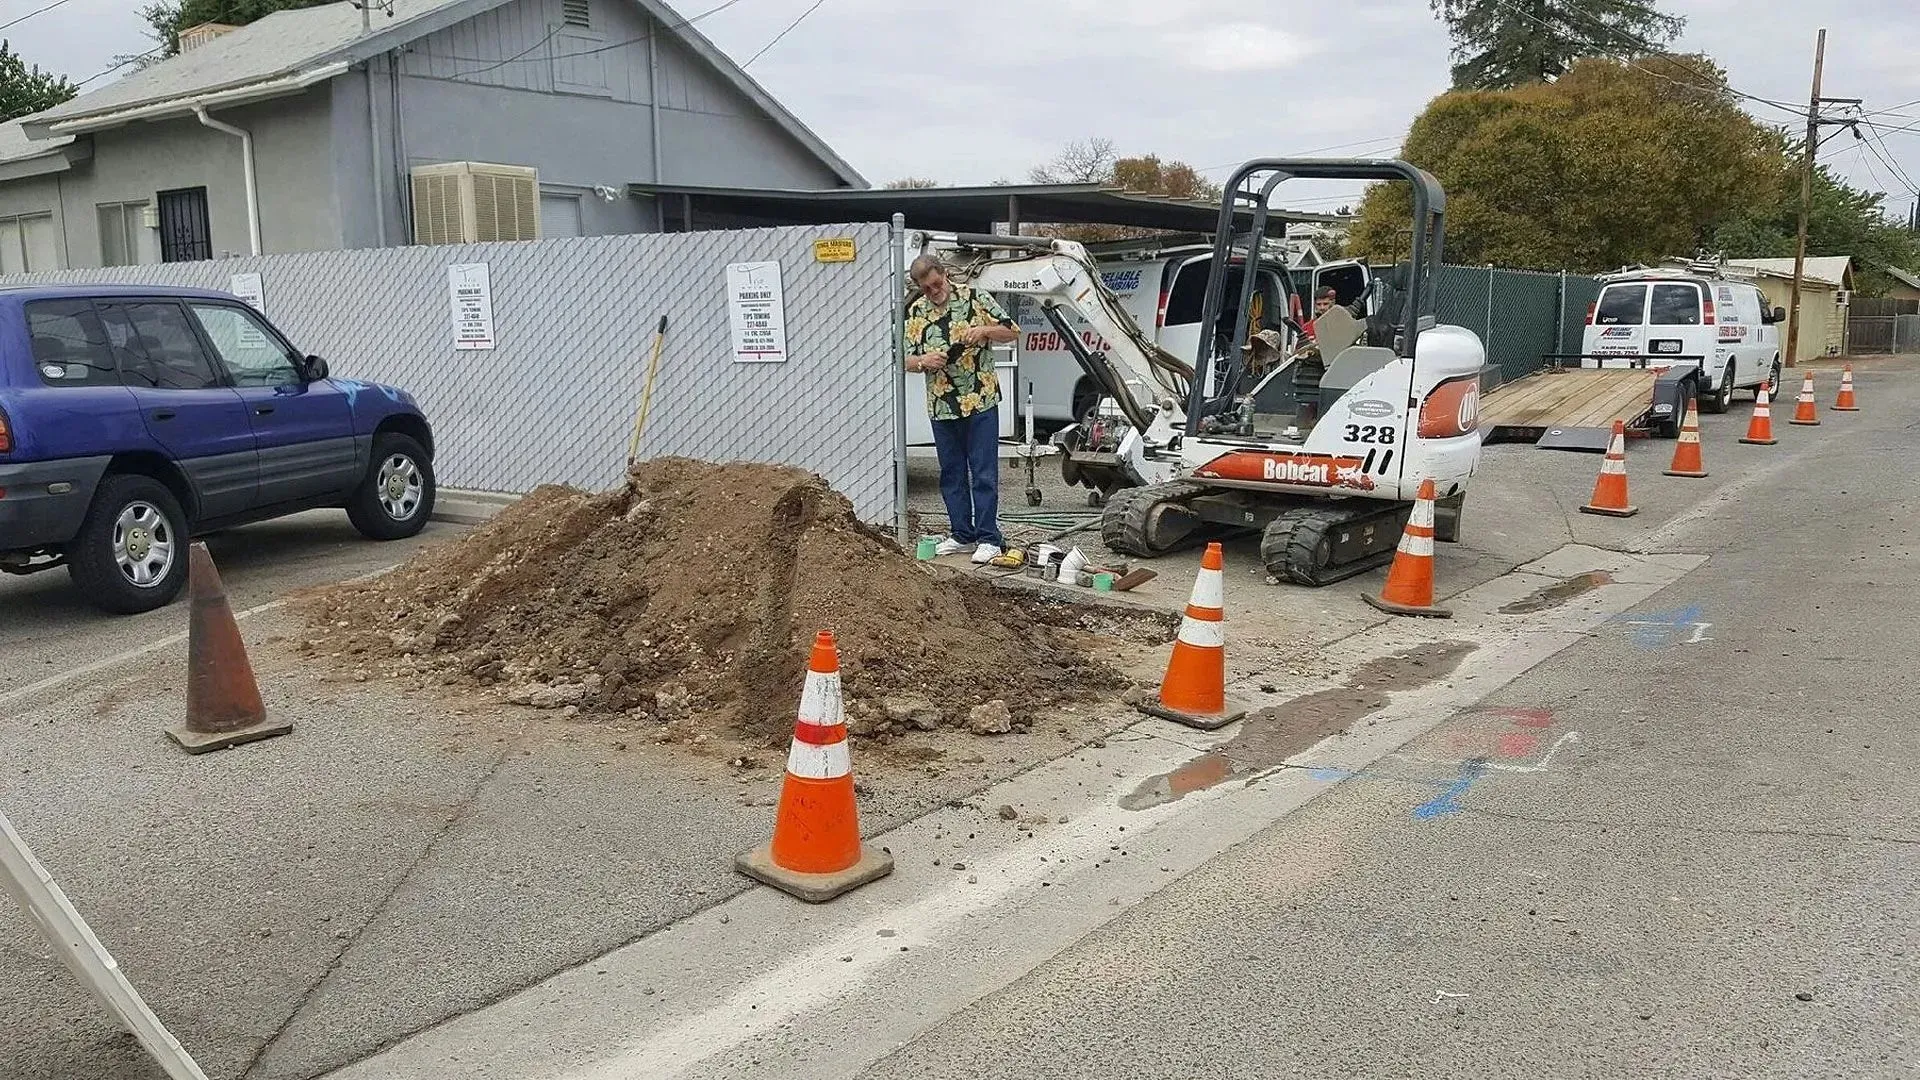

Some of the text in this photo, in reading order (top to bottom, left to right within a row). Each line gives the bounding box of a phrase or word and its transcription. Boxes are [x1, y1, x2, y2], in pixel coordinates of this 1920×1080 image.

[1004, 280, 1029, 288] Bobcat
[739, 291, 771, 300] PARKING ONLY
[1026, 332, 1060, 351] (559)
[1343, 424, 1395, 444] 328
[1264, 458, 1329, 483] Bobcat
